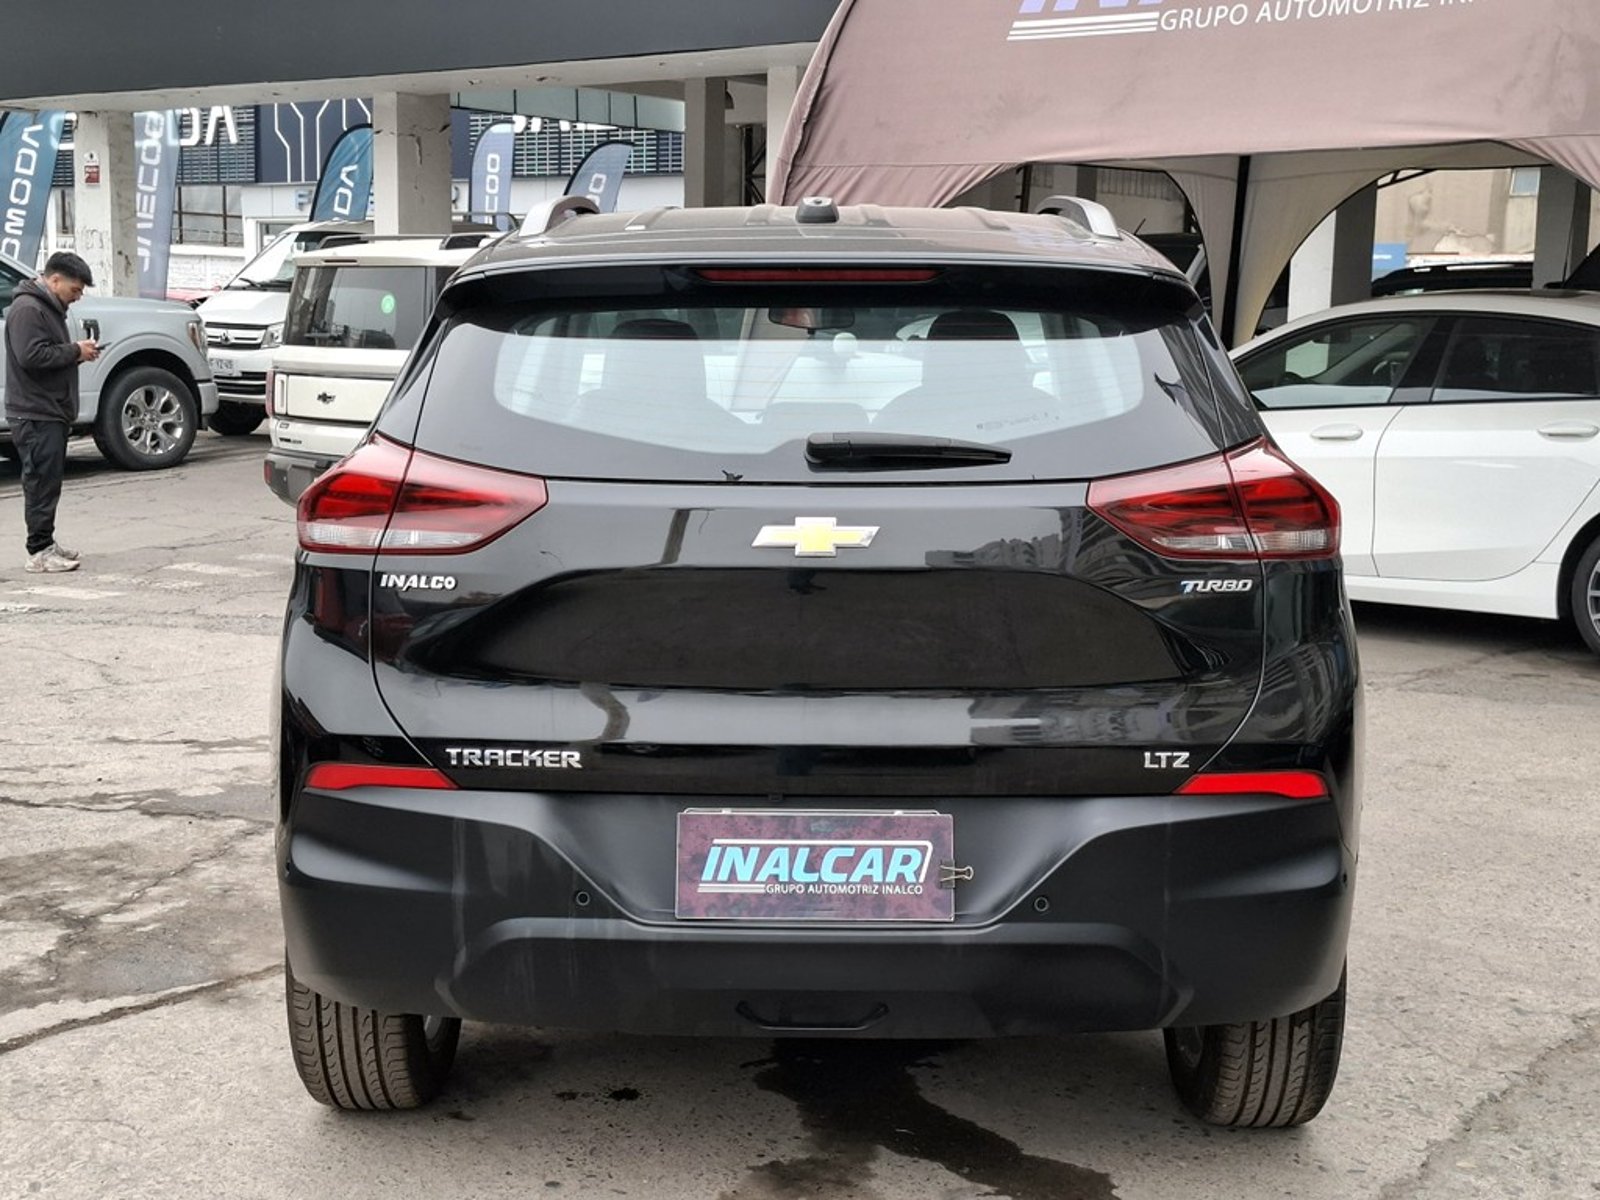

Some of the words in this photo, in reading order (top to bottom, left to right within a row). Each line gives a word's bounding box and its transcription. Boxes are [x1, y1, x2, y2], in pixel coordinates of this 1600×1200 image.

[1160, 4, 1248, 31] GRUPO
[332, 164, 358, 221] DA
[380, 574, 456, 591] INALCO
[1180, 579, 1253, 594] TURBO
[445, 748, 583, 769] TRACKER
[1144, 752, 1190, 768] LTZ
[701, 846, 923, 882] INALCAR
[766, 884, 804, 895] GRUPO
[807, 884, 879, 895] AUTOMOTRIZ
[882, 884, 923, 895] INALCO
